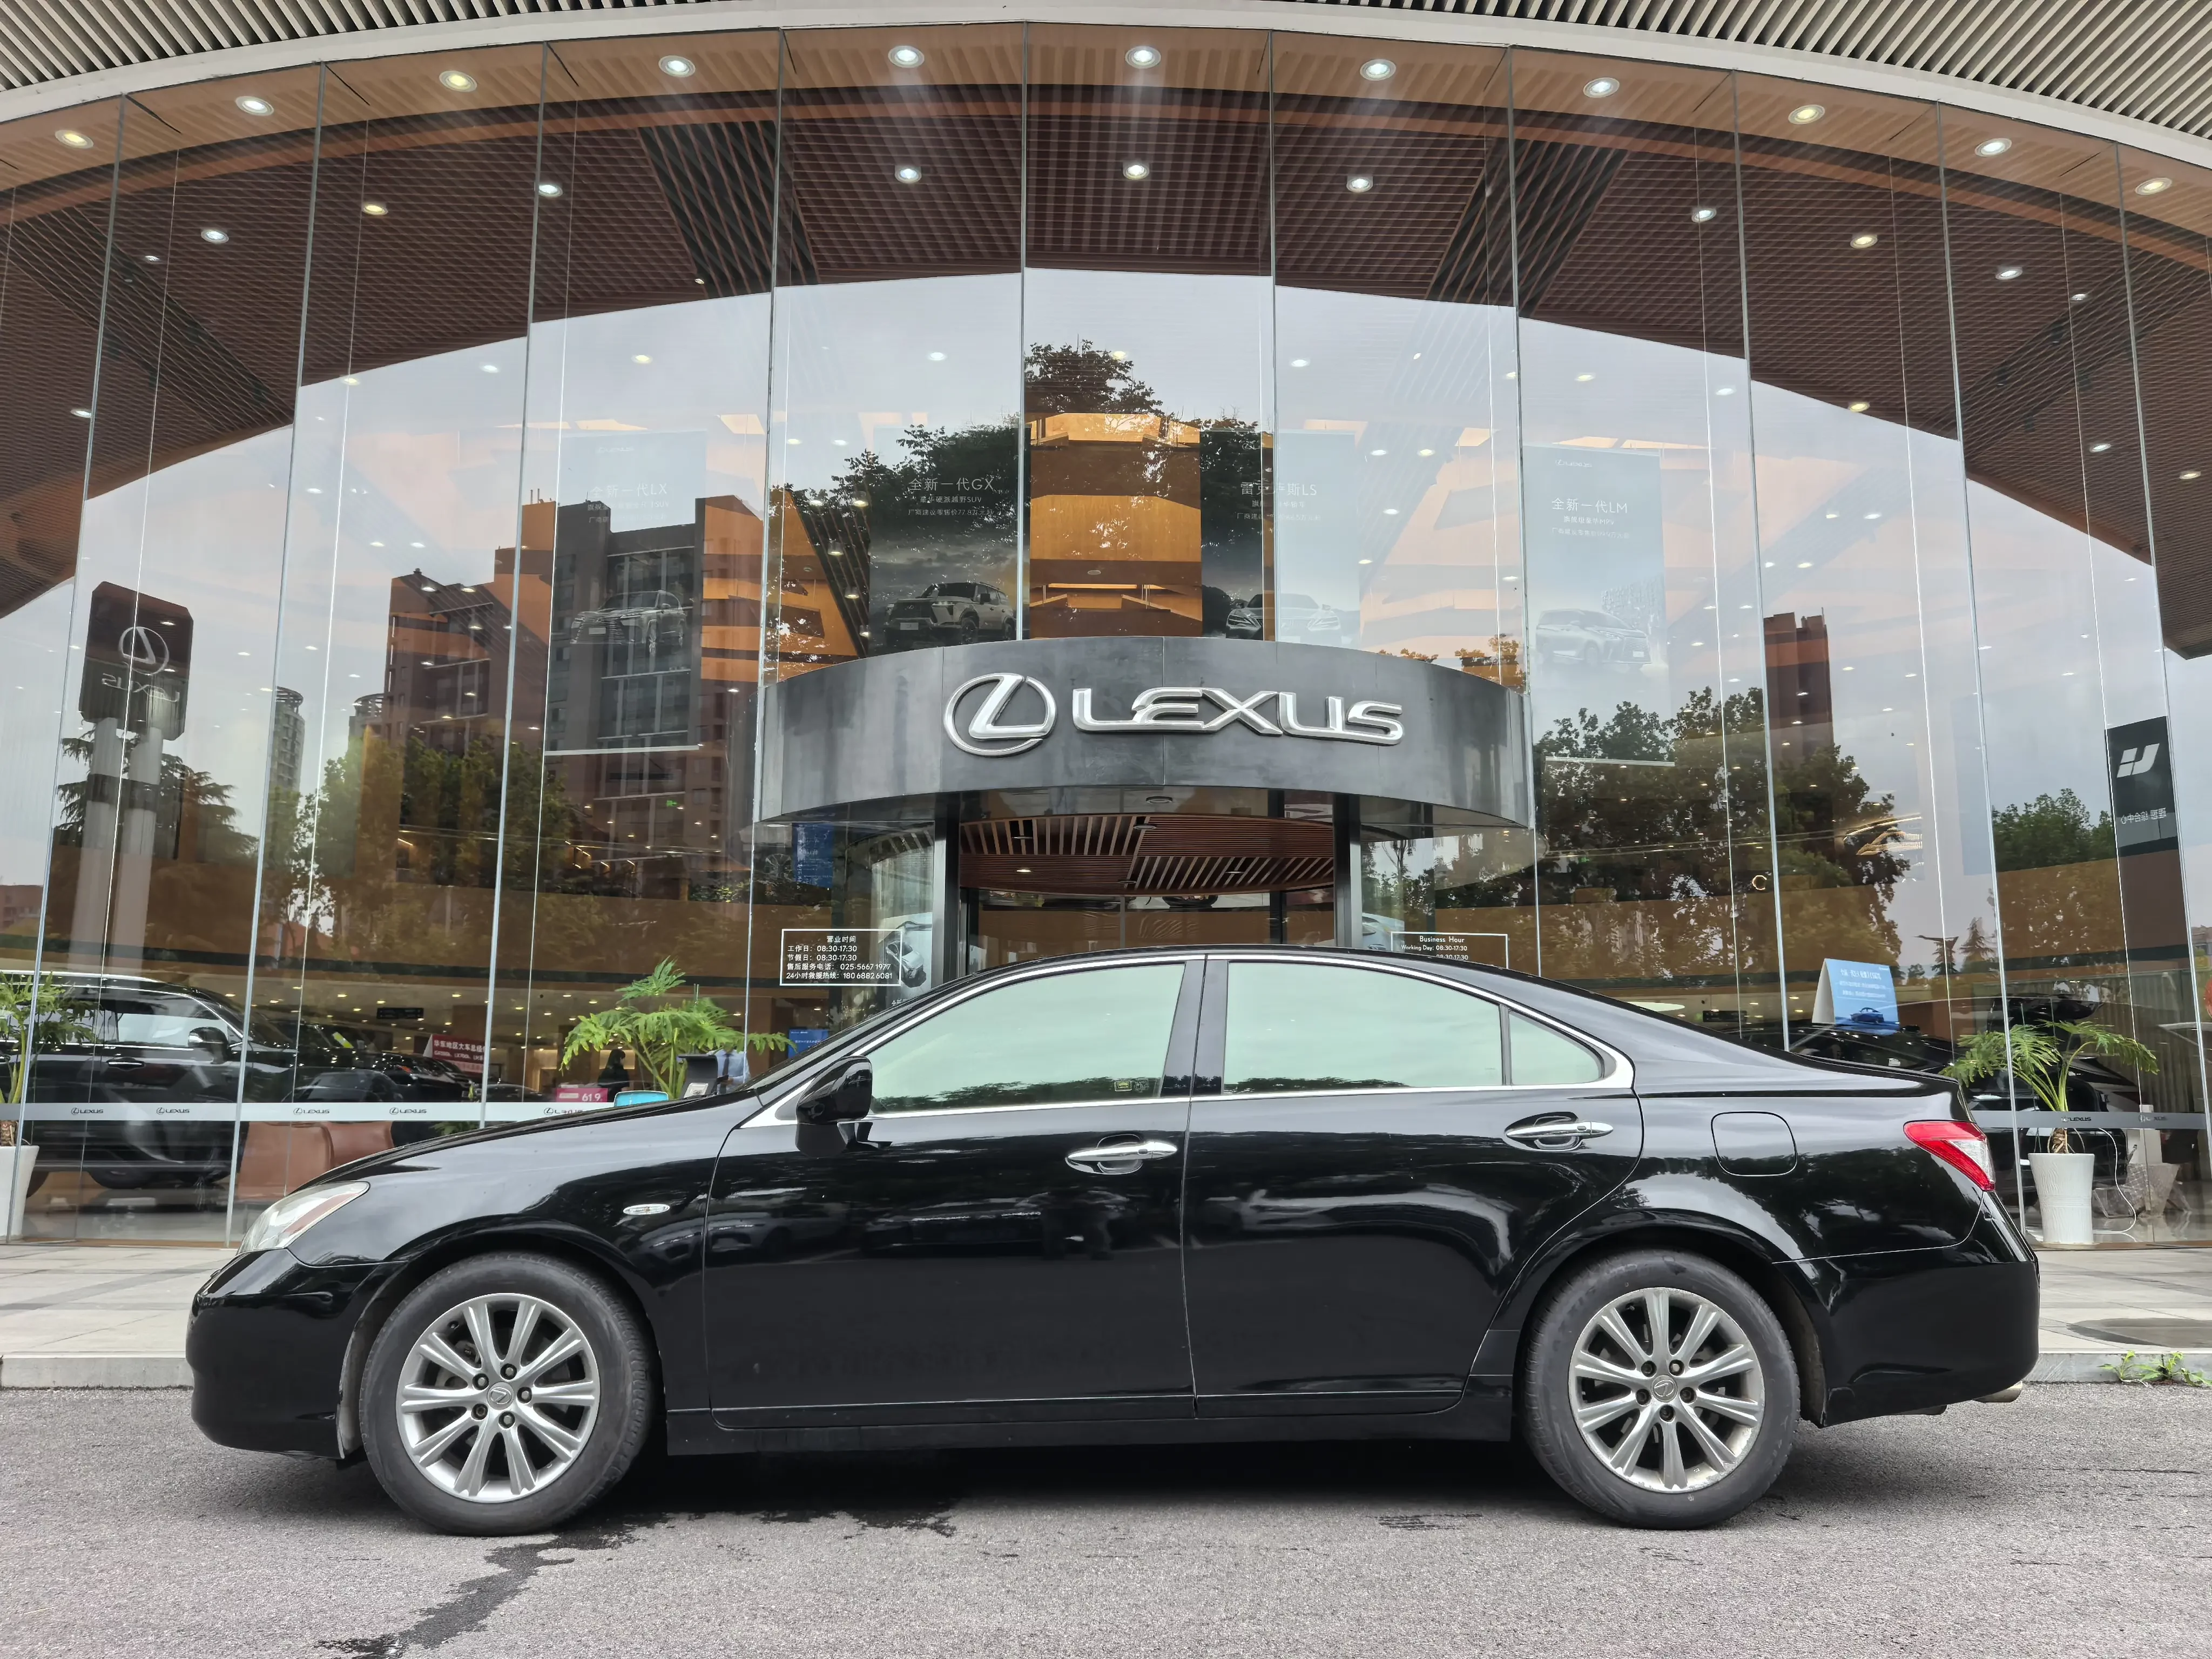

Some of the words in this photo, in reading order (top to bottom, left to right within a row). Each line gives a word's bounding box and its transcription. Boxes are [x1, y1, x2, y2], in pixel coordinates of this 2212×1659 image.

[590, 482, 667, 498] 全新一代LX
[908, 477, 994, 491] 全新一代GX
[1552, 497, 1628, 514] 全新一代LM
[1073, 687, 1405, 746] LEXUS
